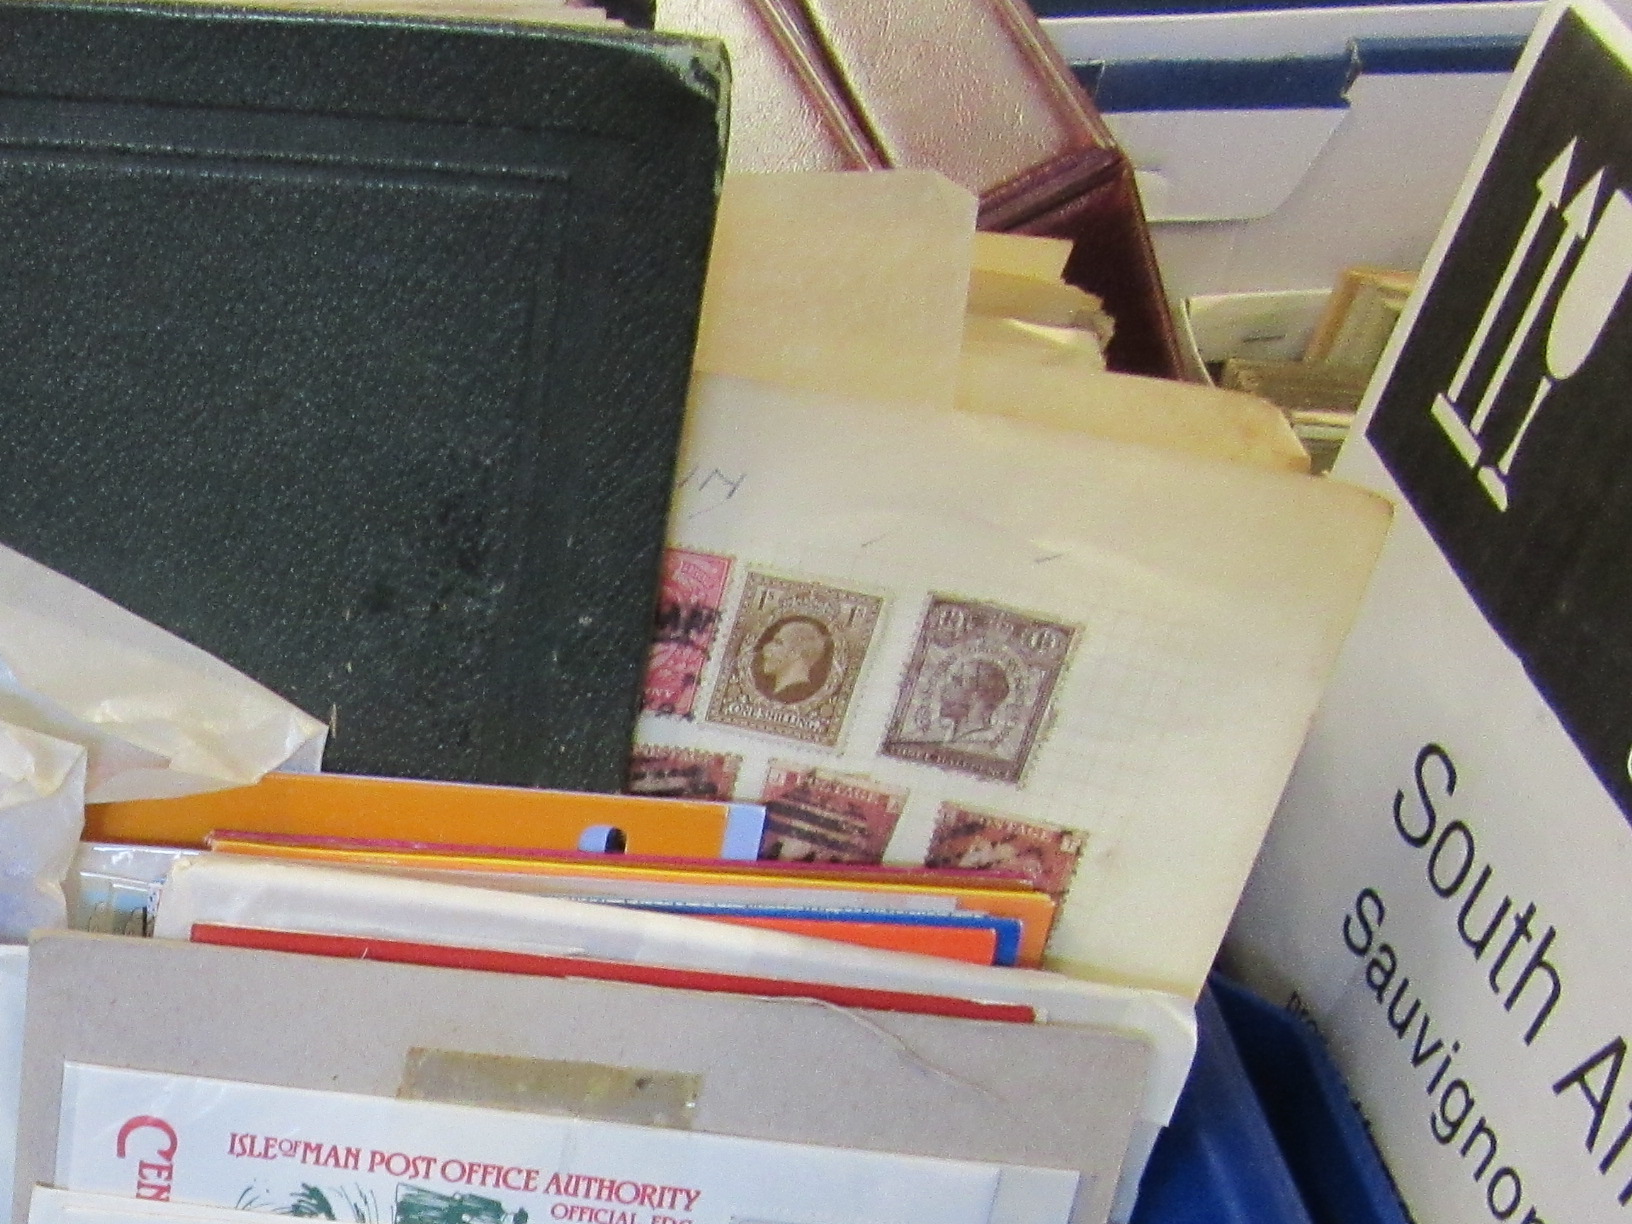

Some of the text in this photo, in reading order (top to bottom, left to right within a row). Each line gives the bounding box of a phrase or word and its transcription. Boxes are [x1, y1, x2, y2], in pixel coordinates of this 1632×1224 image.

[1393, 743, 1562, 1046] South
[300, 1141, 361, 1171] MAN
[368, 1149, 437, 1180] POST
[440, 1158, 540, 1193] OFFICE
[543, 1172, 702, 1212] AUTHORITY
